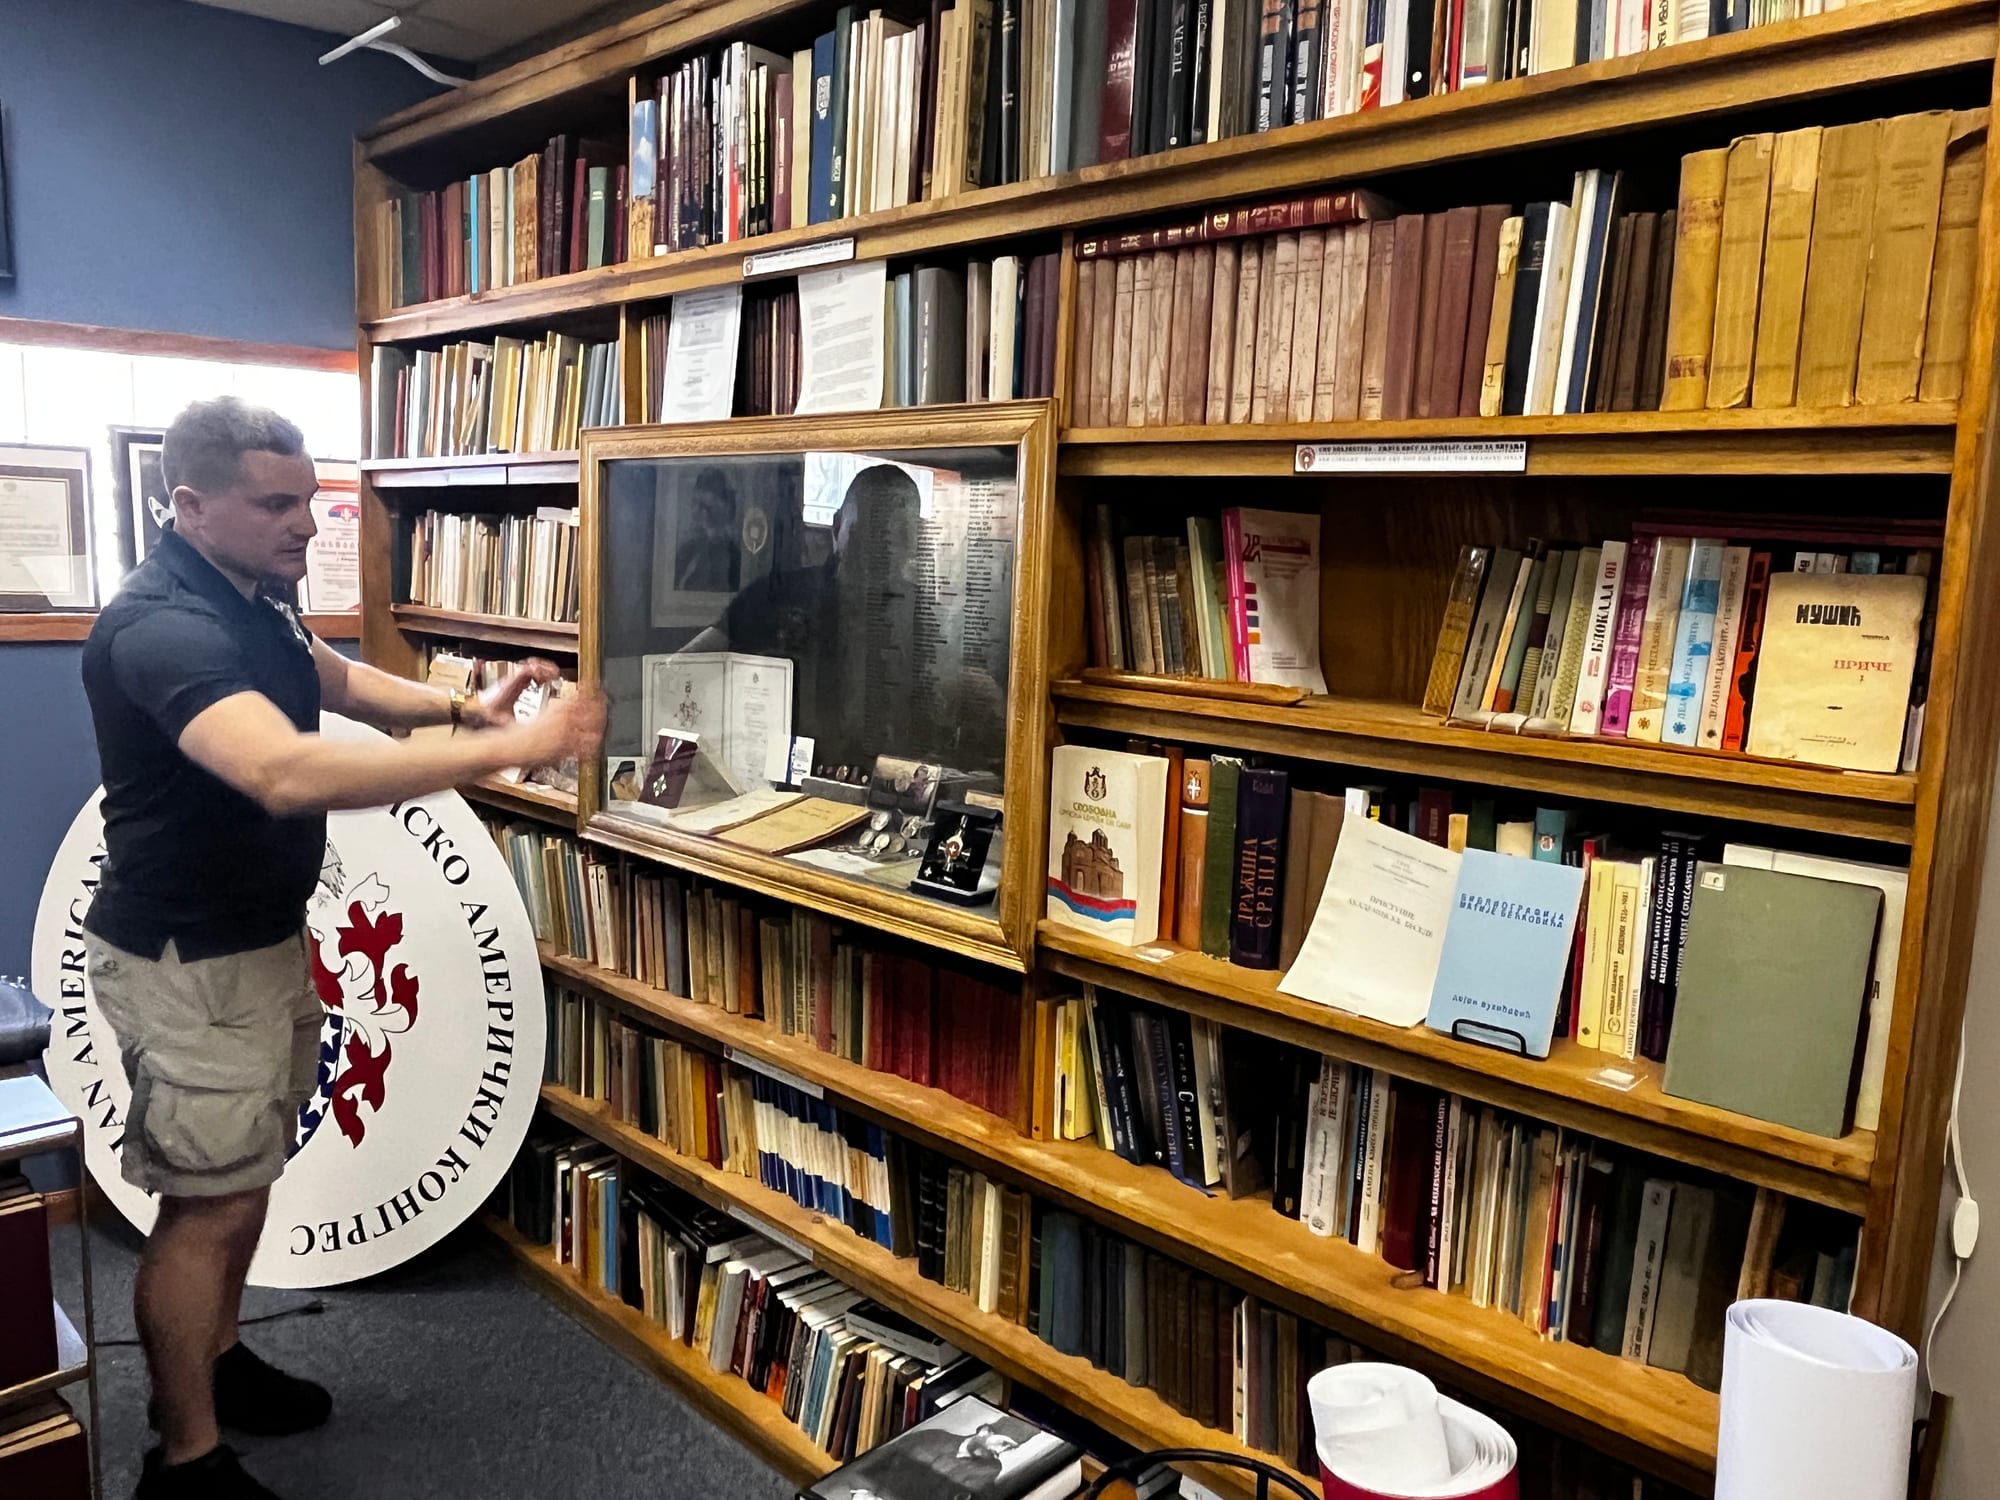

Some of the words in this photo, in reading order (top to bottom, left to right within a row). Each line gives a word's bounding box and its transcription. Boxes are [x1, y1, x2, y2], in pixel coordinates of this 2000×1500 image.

[1796, 604, 1861, 627] НУШИЋ
[1833, 659, 1893, 673] ПРИЧЕ
[389, 800, 470, 885] СКО
[1255, 837, 1278, 929] СРБИЈА
[459, 902, 514, 1149] АМЕРИЧКИ
[290, 1146, 471, 1256] КОНГРЕС
